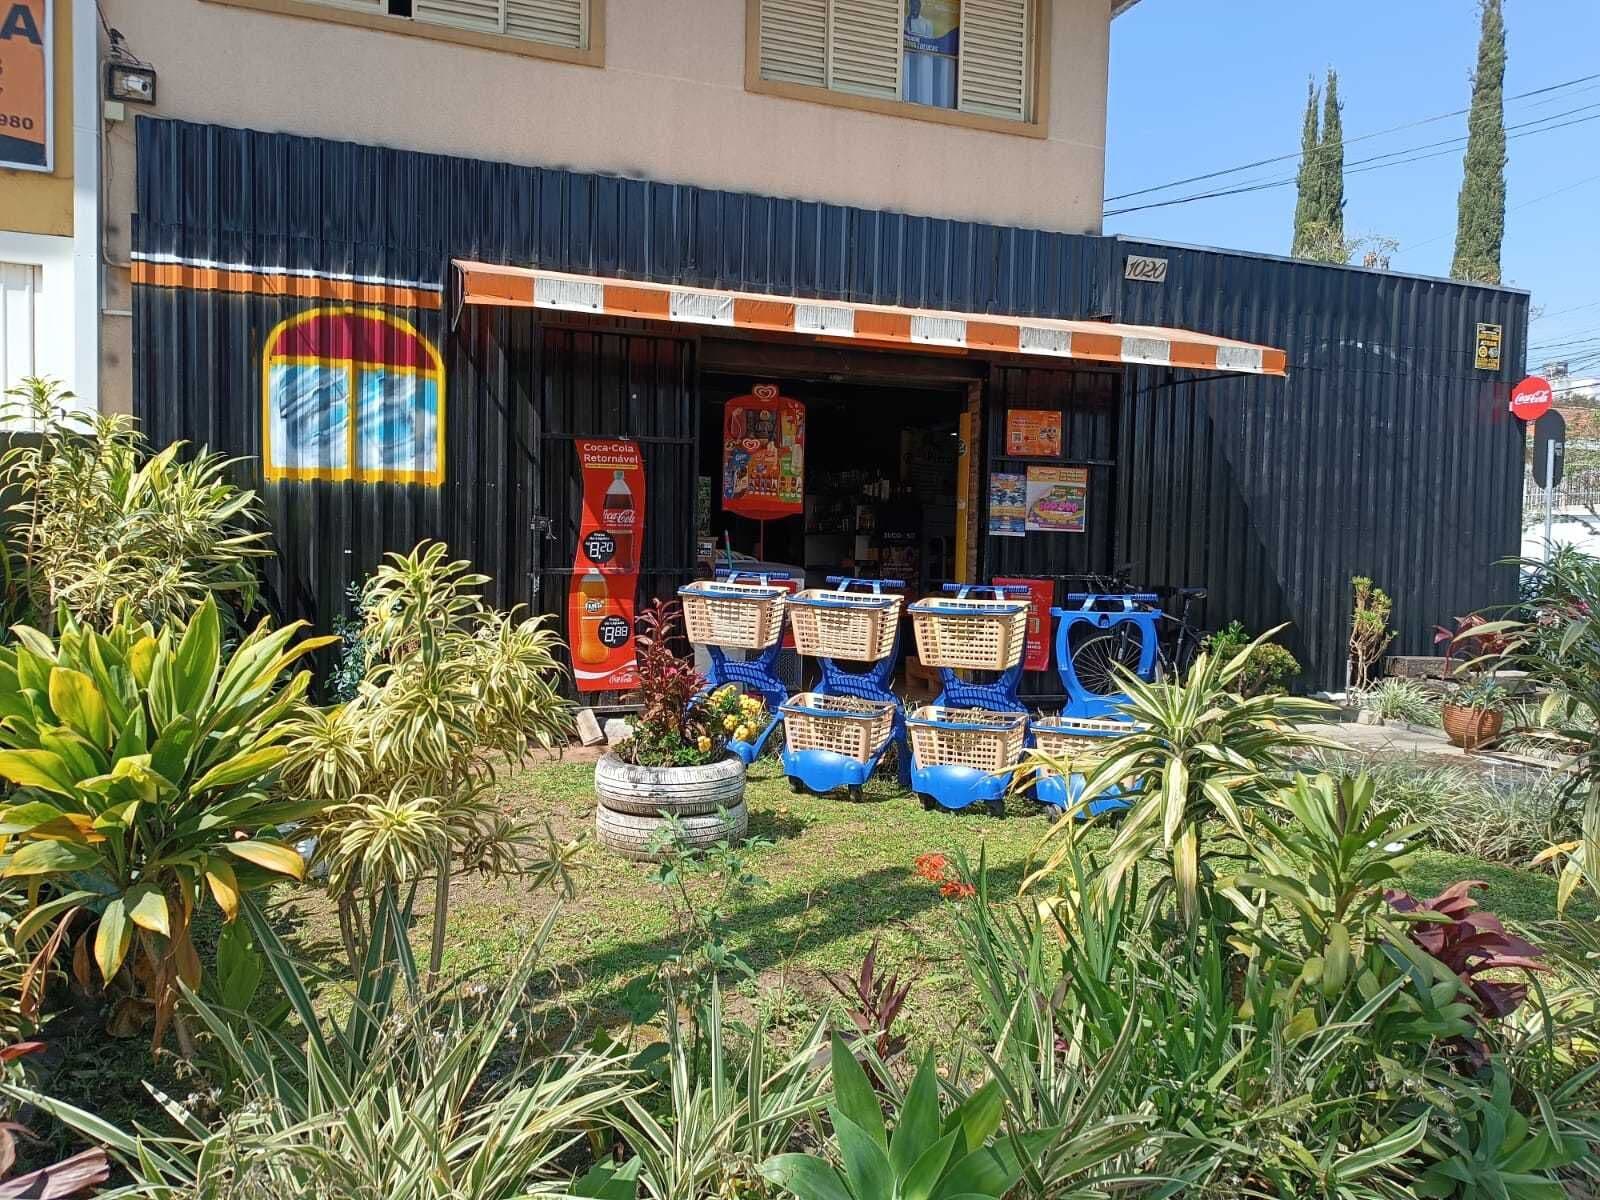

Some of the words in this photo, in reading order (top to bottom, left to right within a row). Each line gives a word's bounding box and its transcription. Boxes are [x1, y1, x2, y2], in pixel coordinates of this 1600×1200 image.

[1127, 259, 1167, 279] 1020
[1514, 390, 1550, 405] Coca-Cola
[583, 441, 634, 452] Coca-Cola
[583, 453, 639, 464] Retornável
